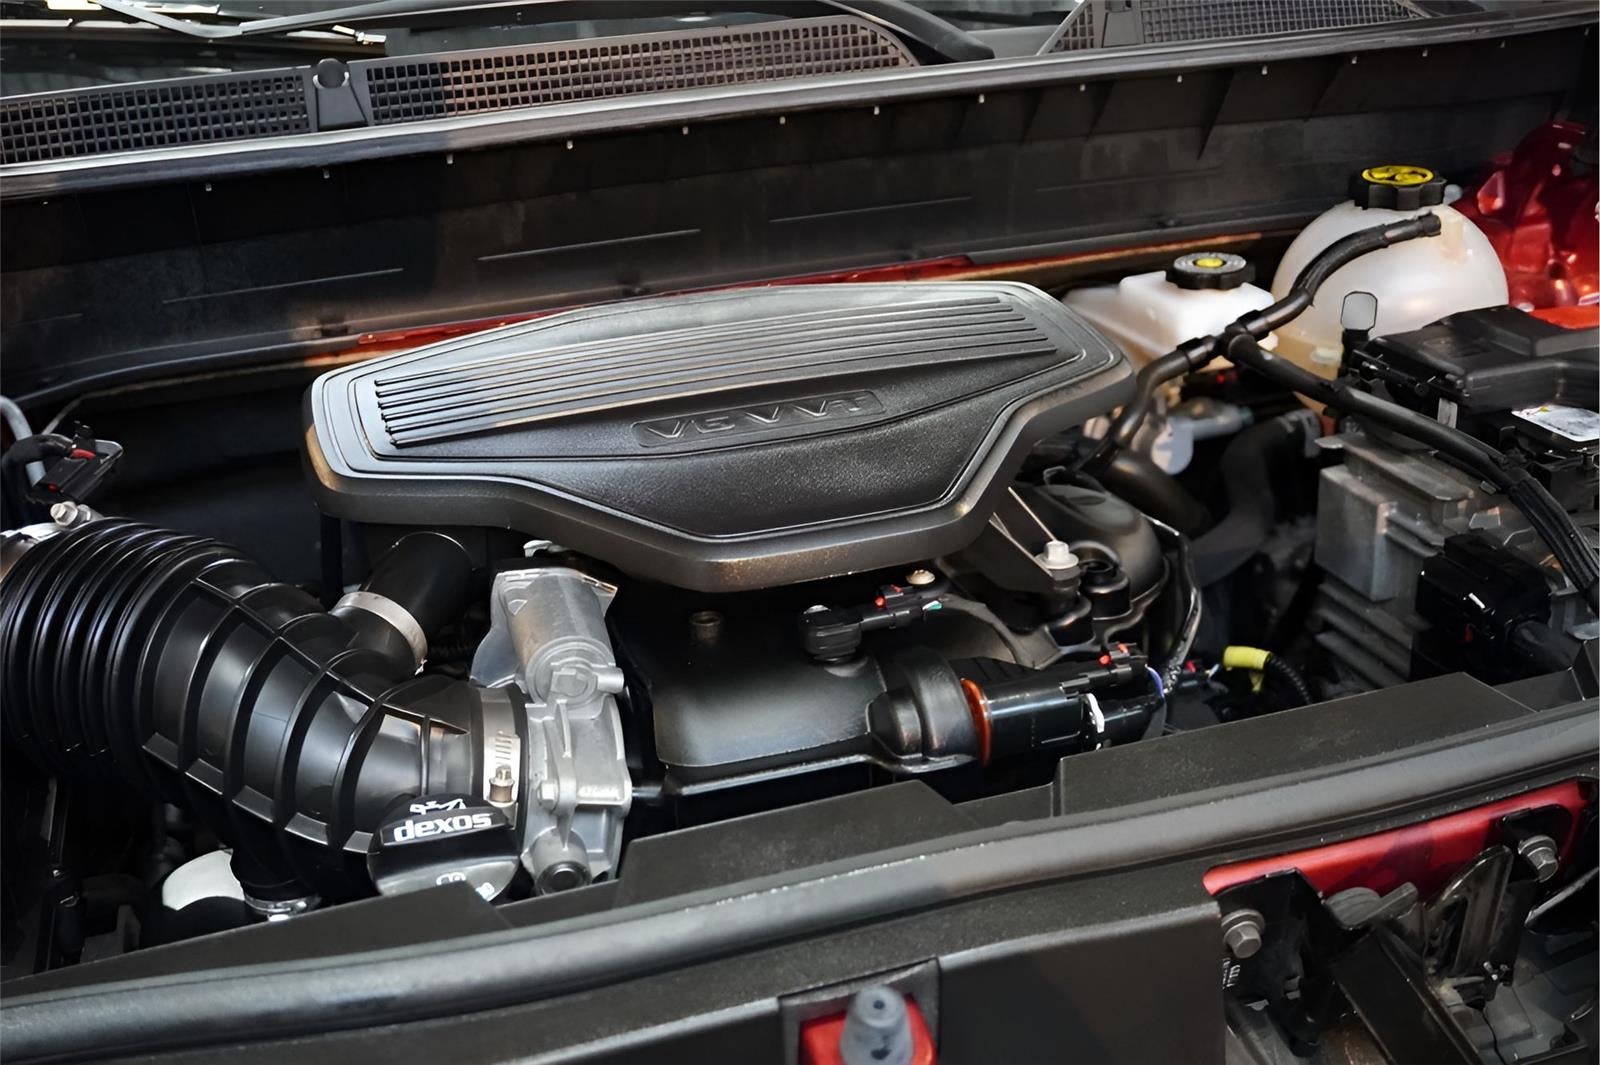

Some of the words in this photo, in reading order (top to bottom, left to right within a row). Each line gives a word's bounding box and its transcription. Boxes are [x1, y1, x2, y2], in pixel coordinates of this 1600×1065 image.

[646, 415, 736, 438] V6
[745, 396, 871, 423] VVT
[394, 812, 494, 842] dexos
